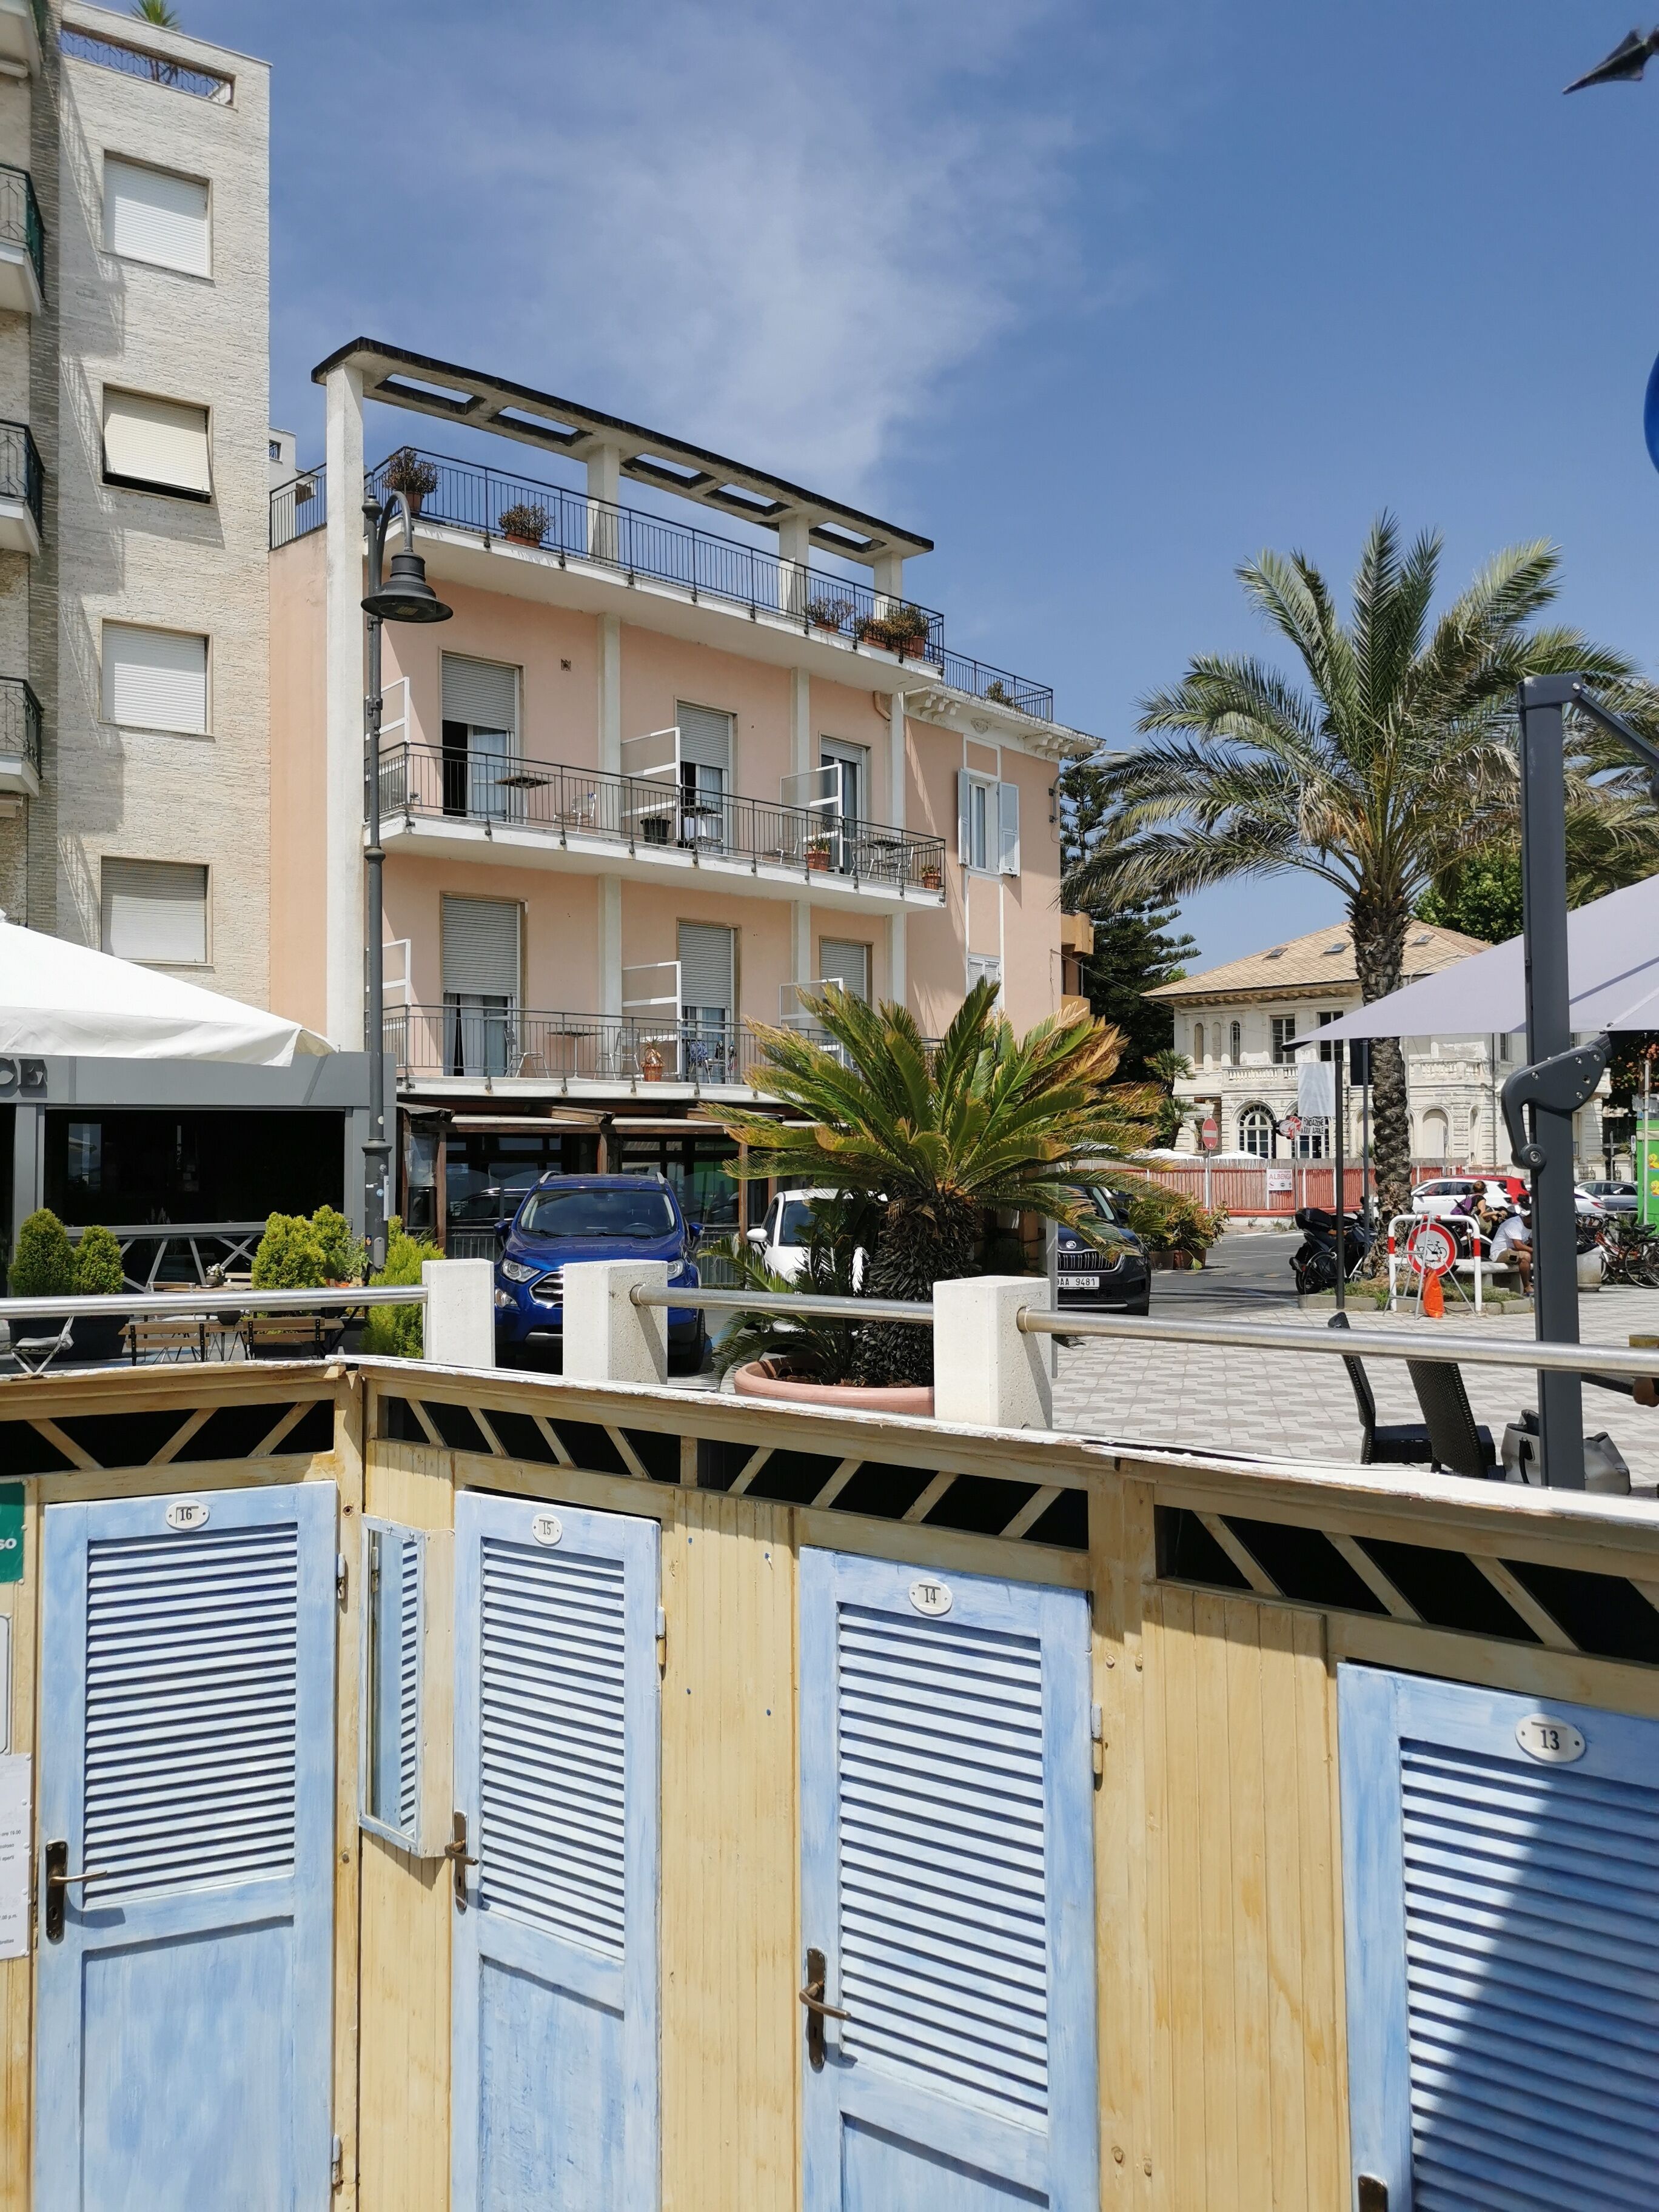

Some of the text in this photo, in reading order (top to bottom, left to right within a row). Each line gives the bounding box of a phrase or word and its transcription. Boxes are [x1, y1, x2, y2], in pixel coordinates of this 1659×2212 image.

[180, 1507, 192, 1521] 16
[543, 1521, 551, 1535] 15
[925, 1587, 936, 1604] 14
[1541, 1729, 1560, 1750] 13
